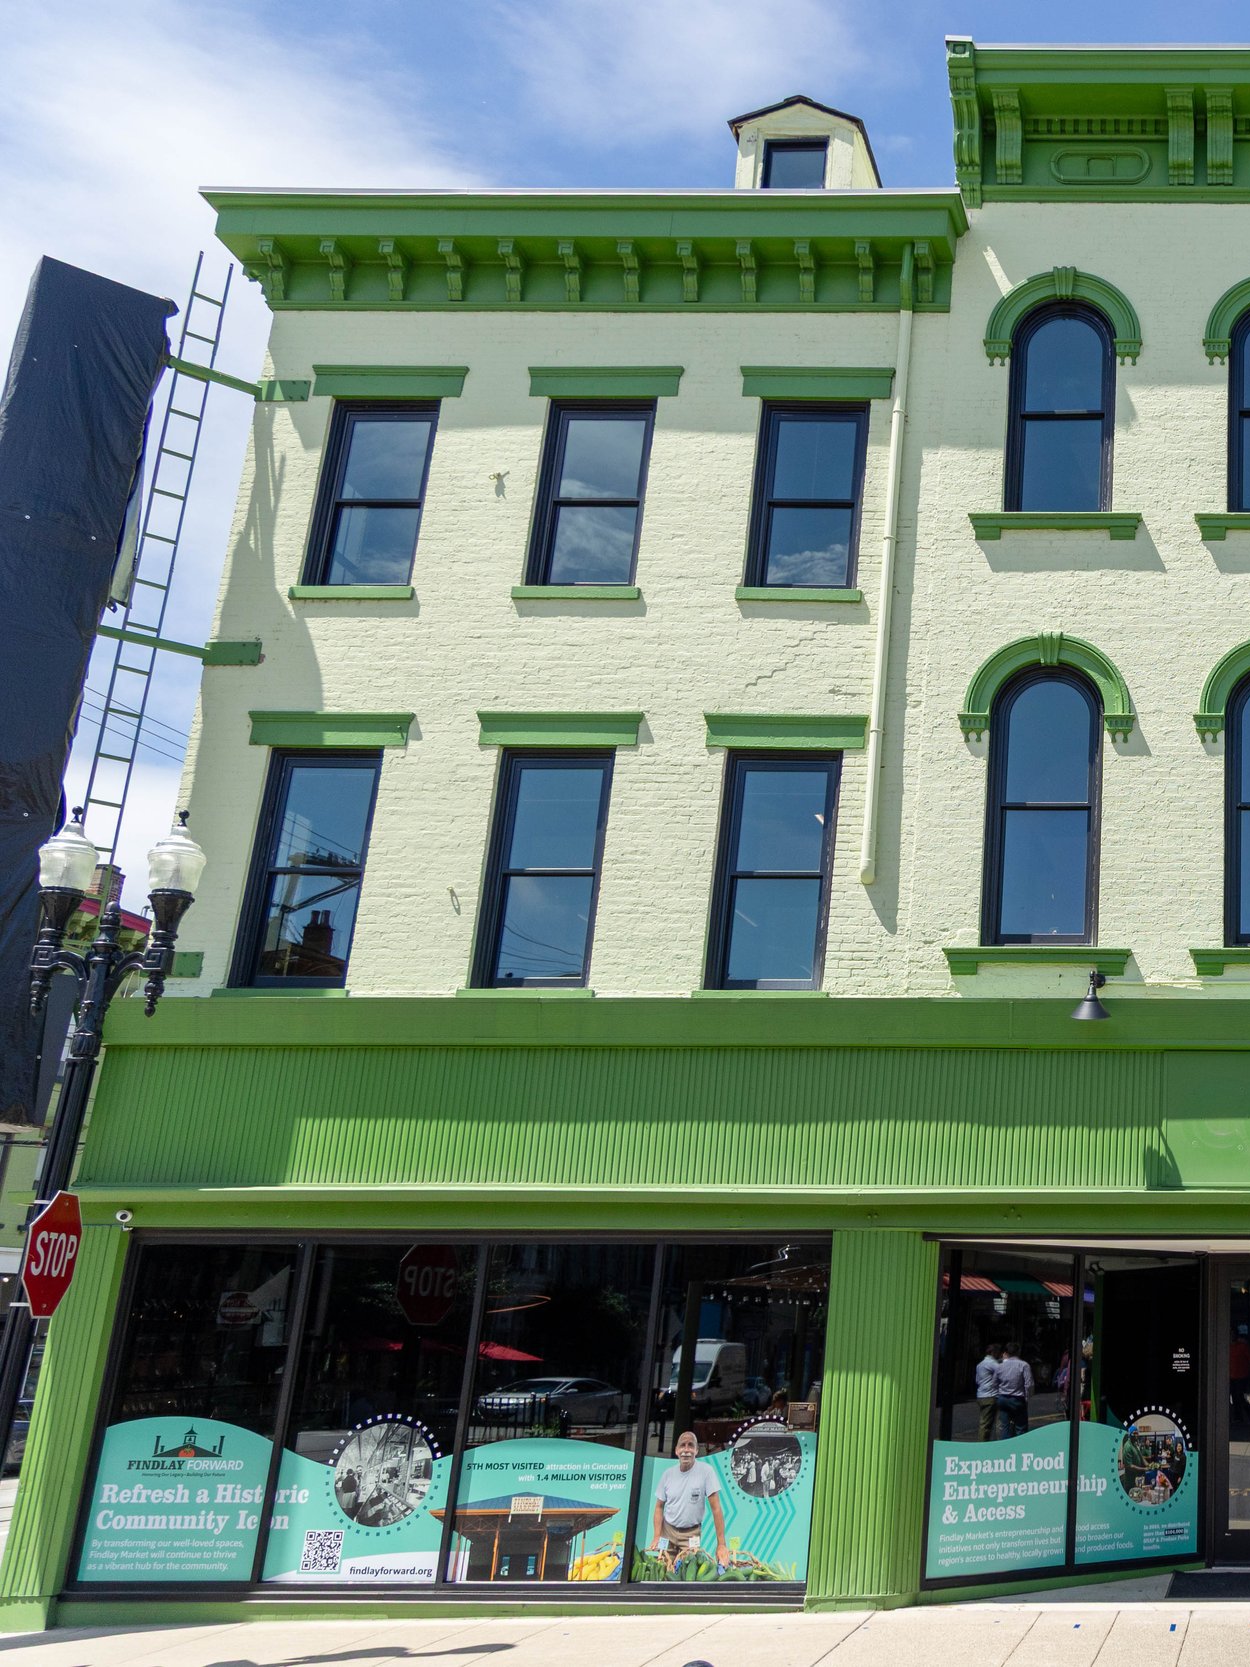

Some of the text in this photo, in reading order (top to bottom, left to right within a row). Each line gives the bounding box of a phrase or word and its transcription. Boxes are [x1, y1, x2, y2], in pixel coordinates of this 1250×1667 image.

[30, 1230, 78, 1278] STOP
[127, 1460, 244, 1470] FINDLAY FORWARD
[546, 1463, 581, 1471] attraction
[592, 1463, 628, 1471] Cincinnati
[944, 1452, 1065, 1480] Expand Food
[100, 1484, 310, 1504] Refresh a Histric
[943, 1474, 1107, 1501] Entrepreneurhip
[96, 1510, 289, 1535] Community Icn
[942, 1504, 1026, 1525] & Access
[939, 1534, 964, 1543] Findlay
[995, 1527, 1051, 1538] entrepreneurship
[1052, 1525, 1064, 1533] and
[92, 1539, 102, 1549] By
[104, 1539, 156, 1549] transforming
[173, 1539, 214, 1547] well-loved
[88, 1551, 119, 1560] Findlay
[120, 1551, 149, 1559] Market
[151, 1551, 165, 1559] will
[166, 1551, 201, 1559] continue
[213, 1551, 237, 1559] thrive
[105, 1562, 134, 1570] vibrant
[136, 1562, 151, 1570] hub
[153, 1562, 165, 1570] for
[166, 1562, 180, 1570] the
[181, 1562, 229, 1572] community.
[349, 1566, 433, 1577] findlayforward.org
